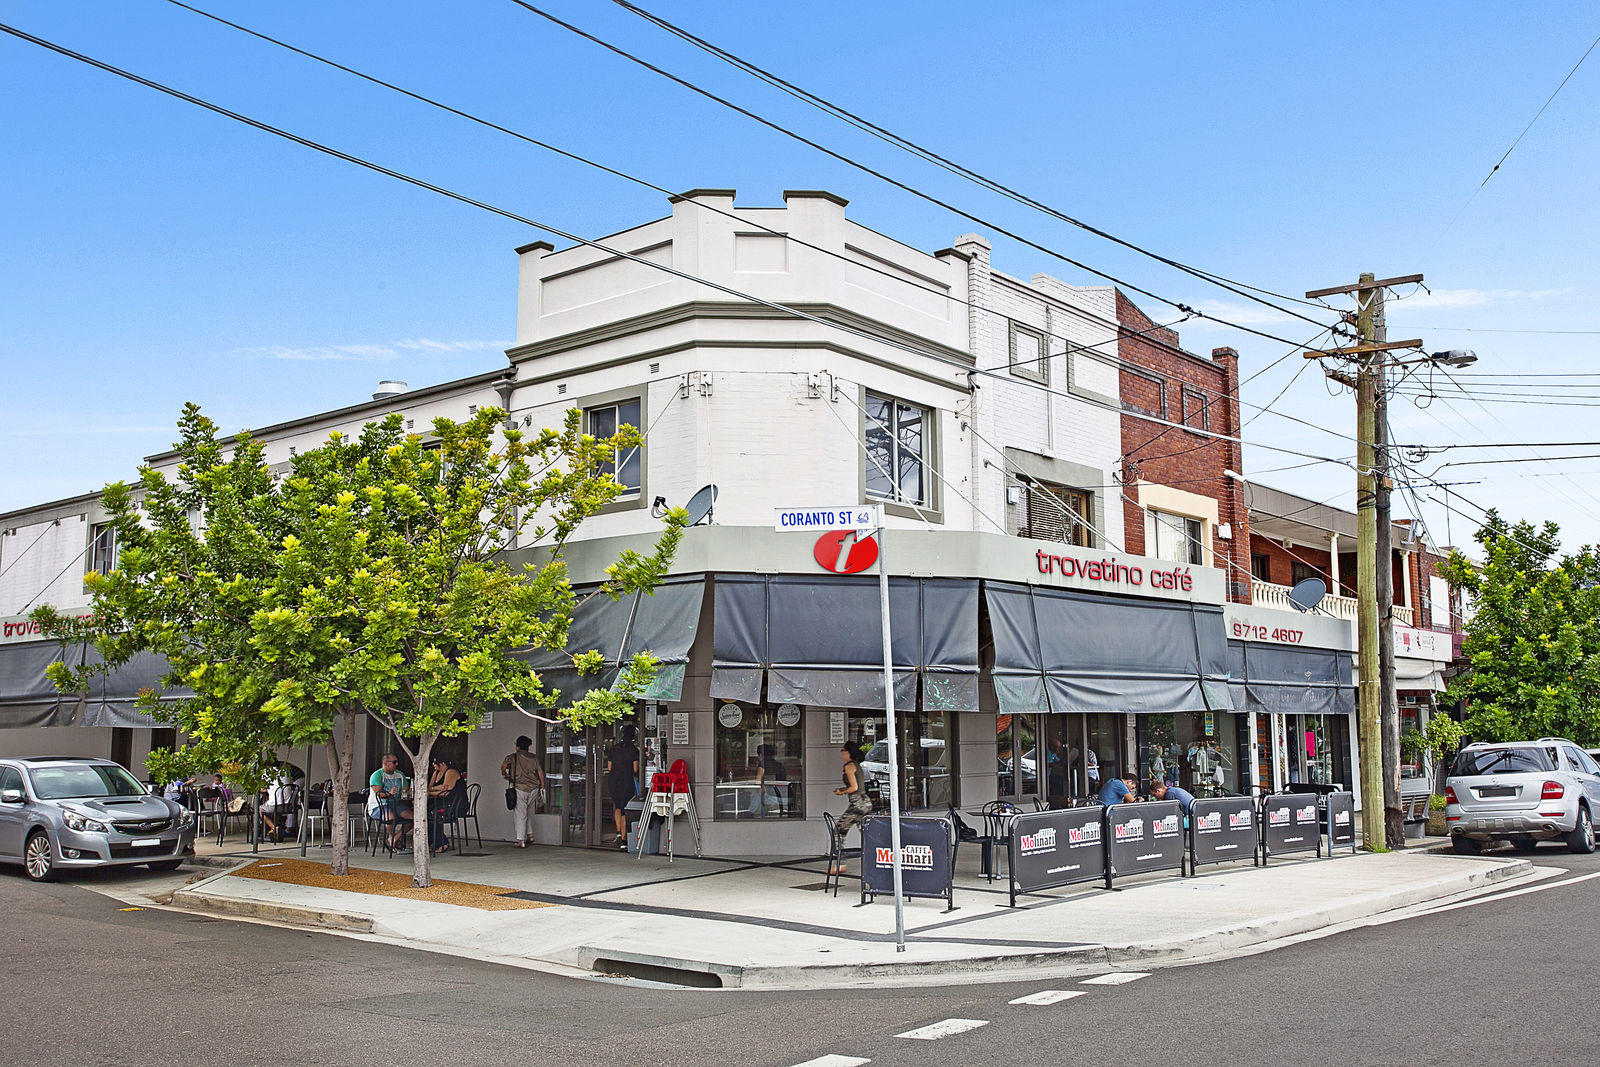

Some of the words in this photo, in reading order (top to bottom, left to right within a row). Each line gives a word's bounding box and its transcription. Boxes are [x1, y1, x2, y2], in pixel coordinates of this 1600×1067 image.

[781, 511, 835, 526] CORANTO
[839, 511, 852, 525] ST
[1036, 549, 1143, 585] trovatino
[1151, 567, 1193, 591] café
[1233, 623, 1268, 640] 9712
[1272, 628, 1304, 644] 4607
[1022, 832, 1055, 849] Molinari
[1070, 826, 1100, 842] Molinari
[877, 849, 932, 865] Moinari
